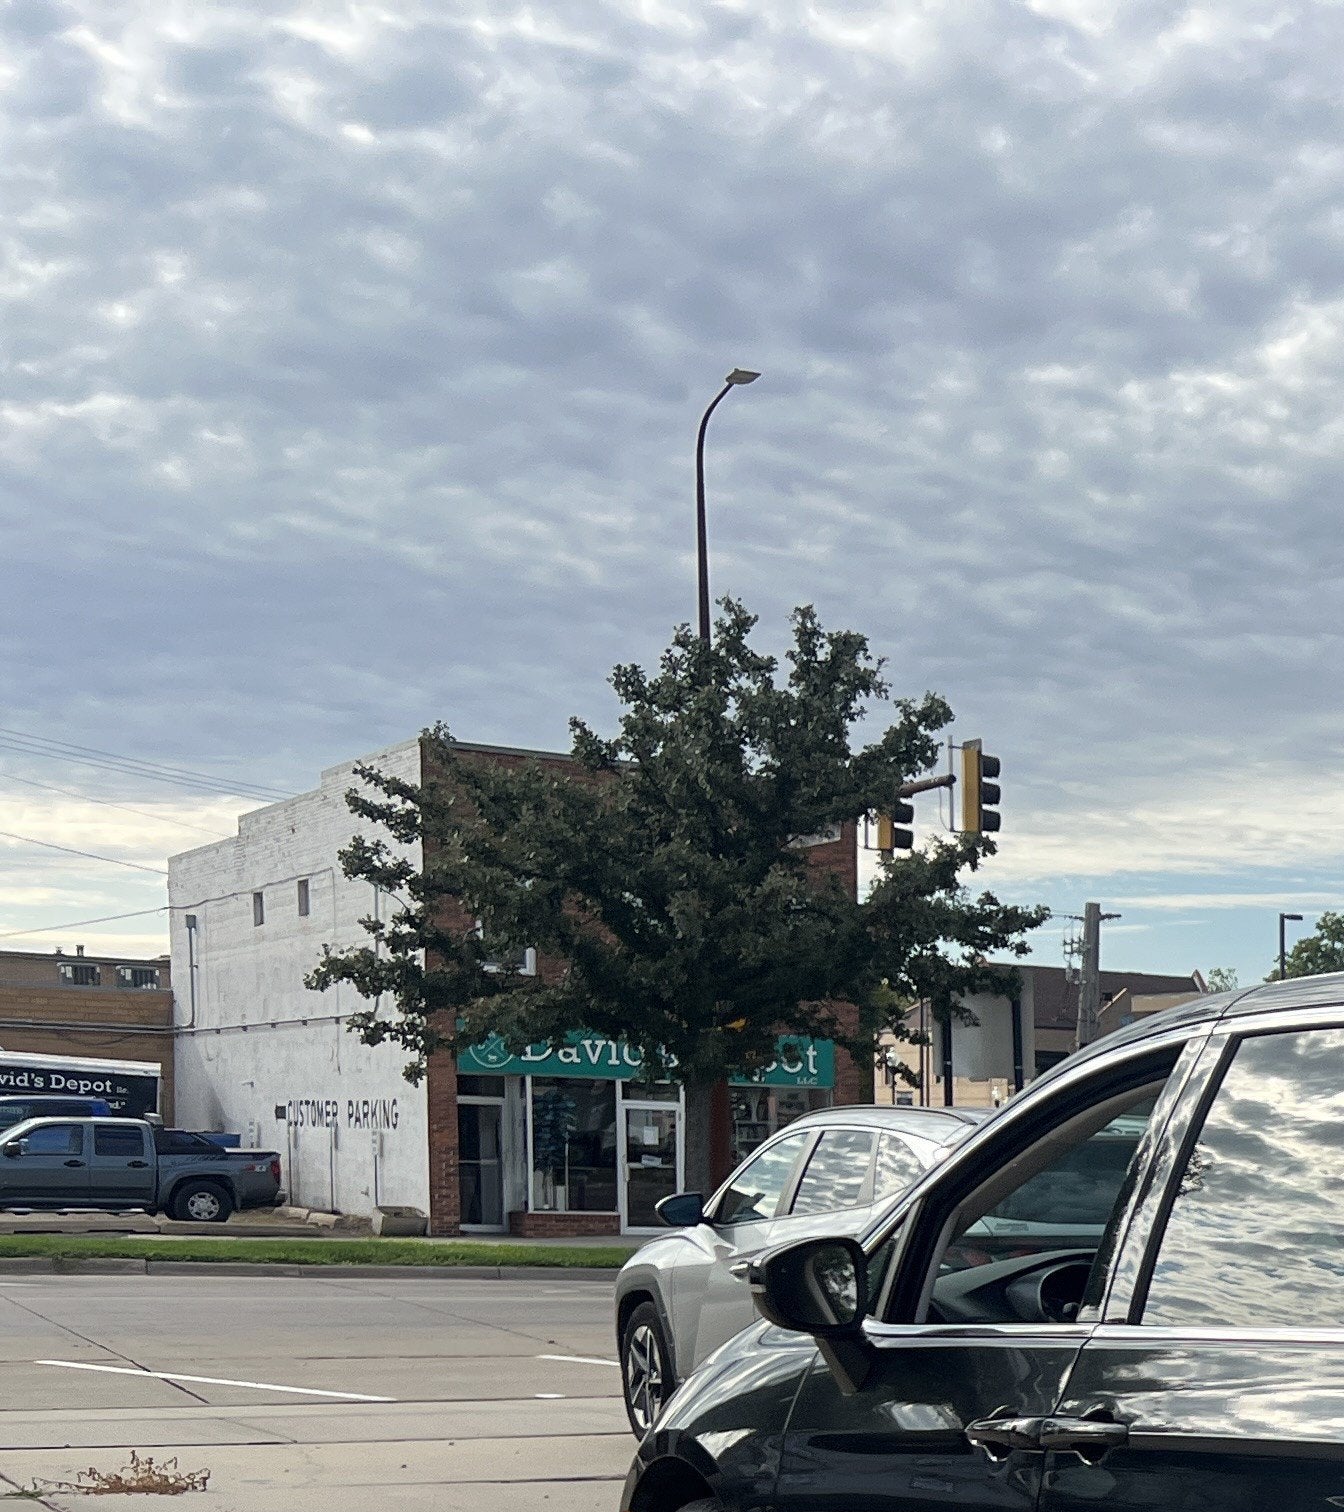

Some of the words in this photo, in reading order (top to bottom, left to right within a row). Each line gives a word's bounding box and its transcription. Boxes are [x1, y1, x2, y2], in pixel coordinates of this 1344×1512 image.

[50, 1074, 112, 1095] Depot
[286, 1099, 339, 1128] CUSTOMER
[347, 1098, 399, 1130] PARKING
